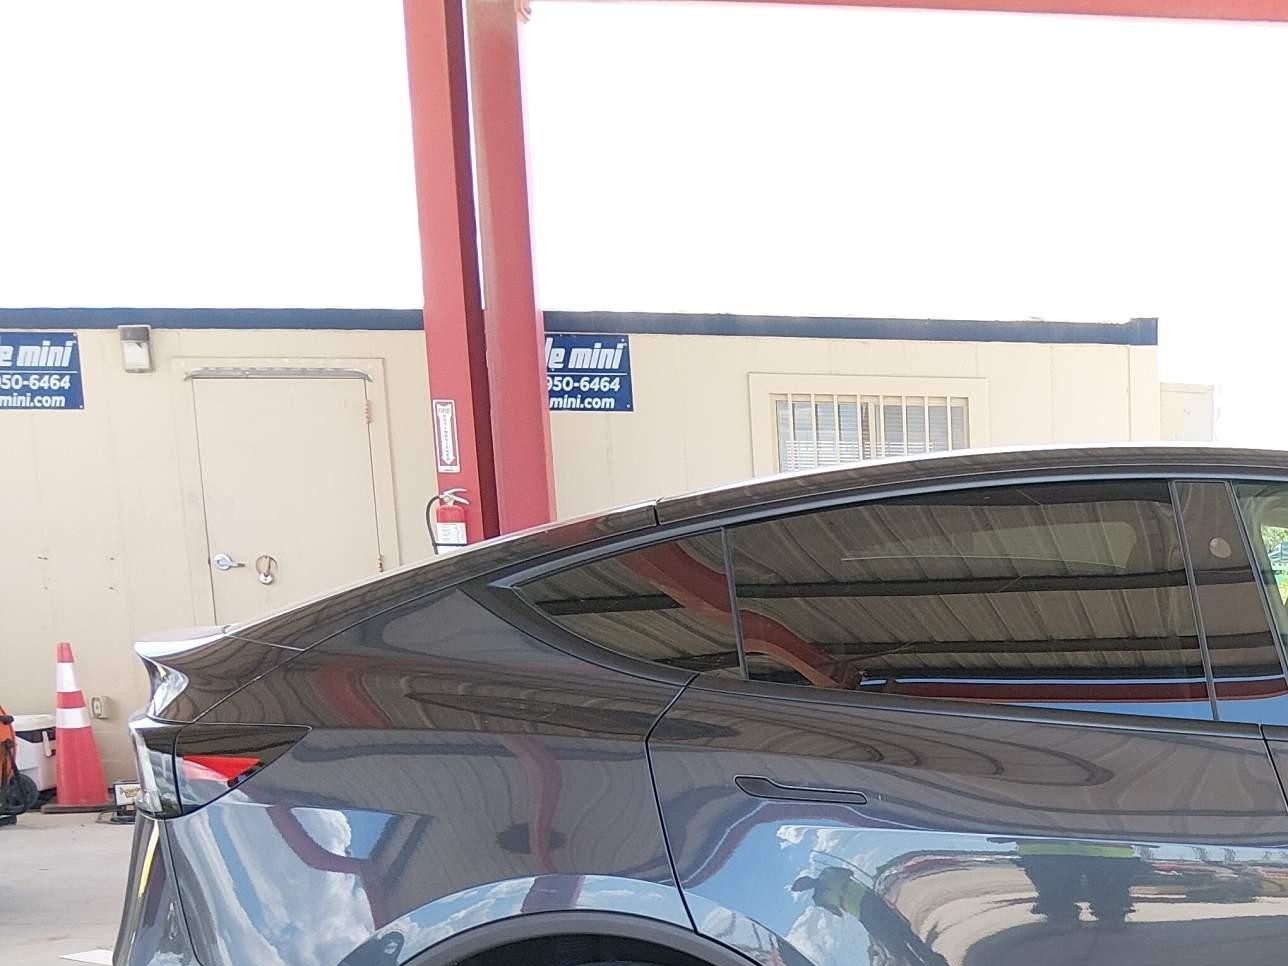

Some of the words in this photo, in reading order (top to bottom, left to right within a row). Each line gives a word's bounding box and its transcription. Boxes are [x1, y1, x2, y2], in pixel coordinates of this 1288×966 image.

[16, 340, 73, 367] mini
[568, 342, 624, 369] mini
[0, 374, 71, 390] 50-6464
[549, 394, 616, 409] mini.com
